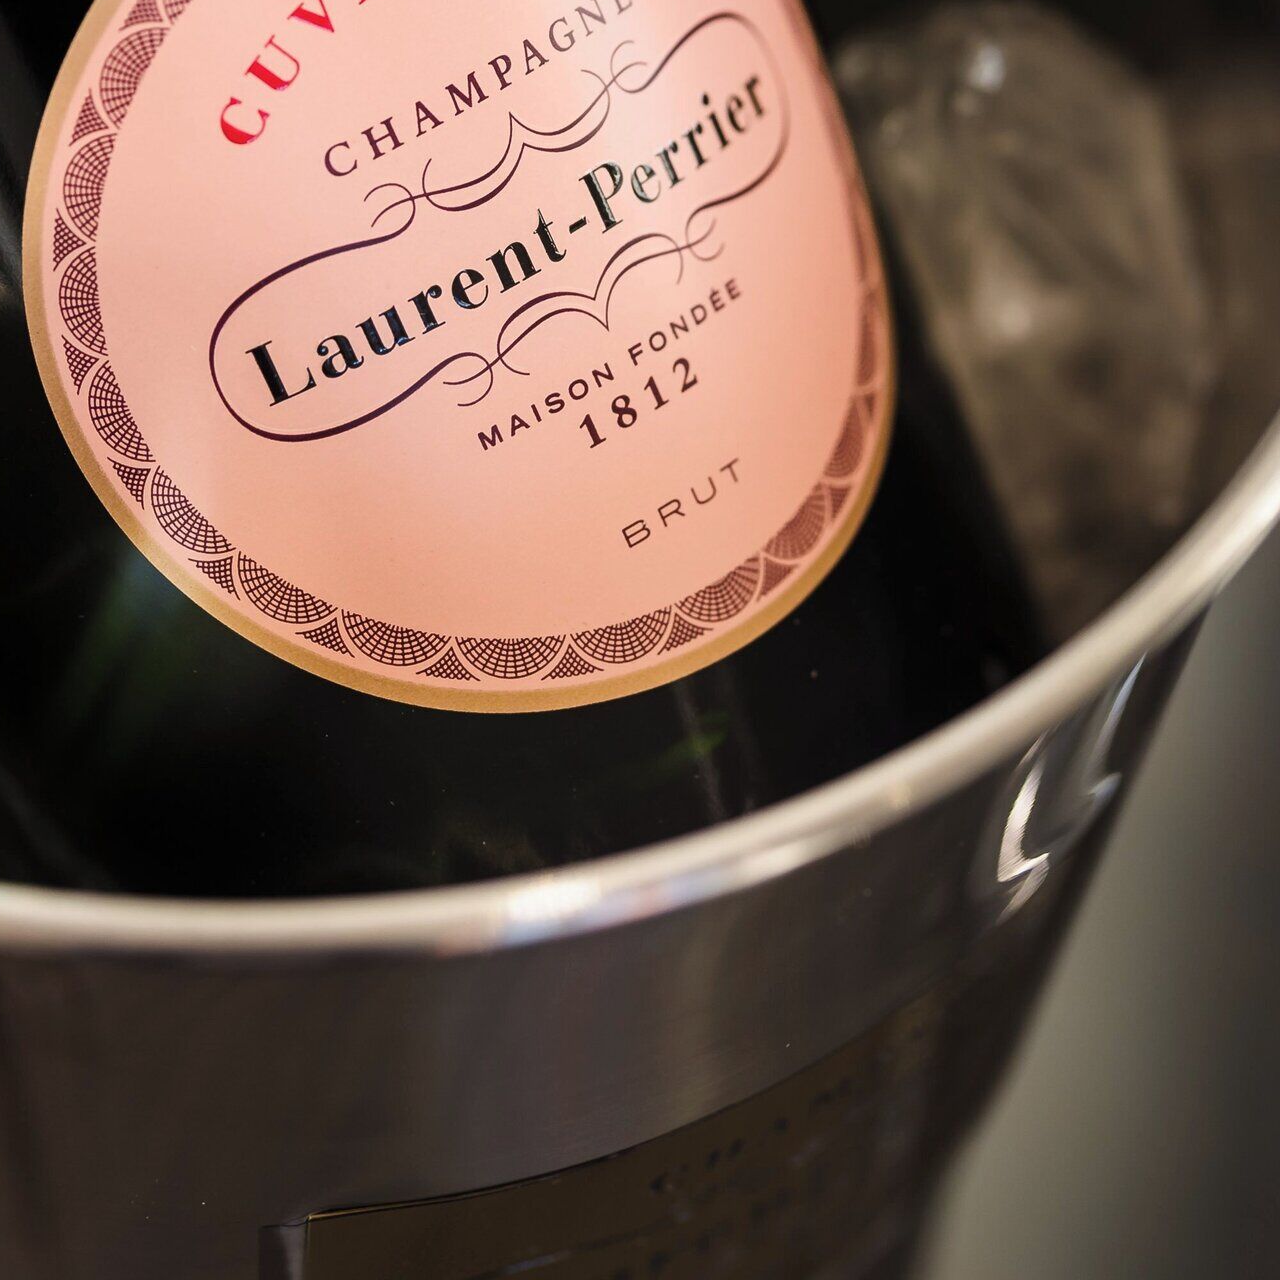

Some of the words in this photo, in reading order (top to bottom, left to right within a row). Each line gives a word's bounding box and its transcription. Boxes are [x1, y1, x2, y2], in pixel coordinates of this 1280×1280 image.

[245, 74, 764, 408] Laurent-Perrier
[477, 362, 615, 451] MAISON
[627, 277, 743, 366] FONDÉE
[579, 357, 699, 449] 1812
[621, 457, 740, 549] BRUT
